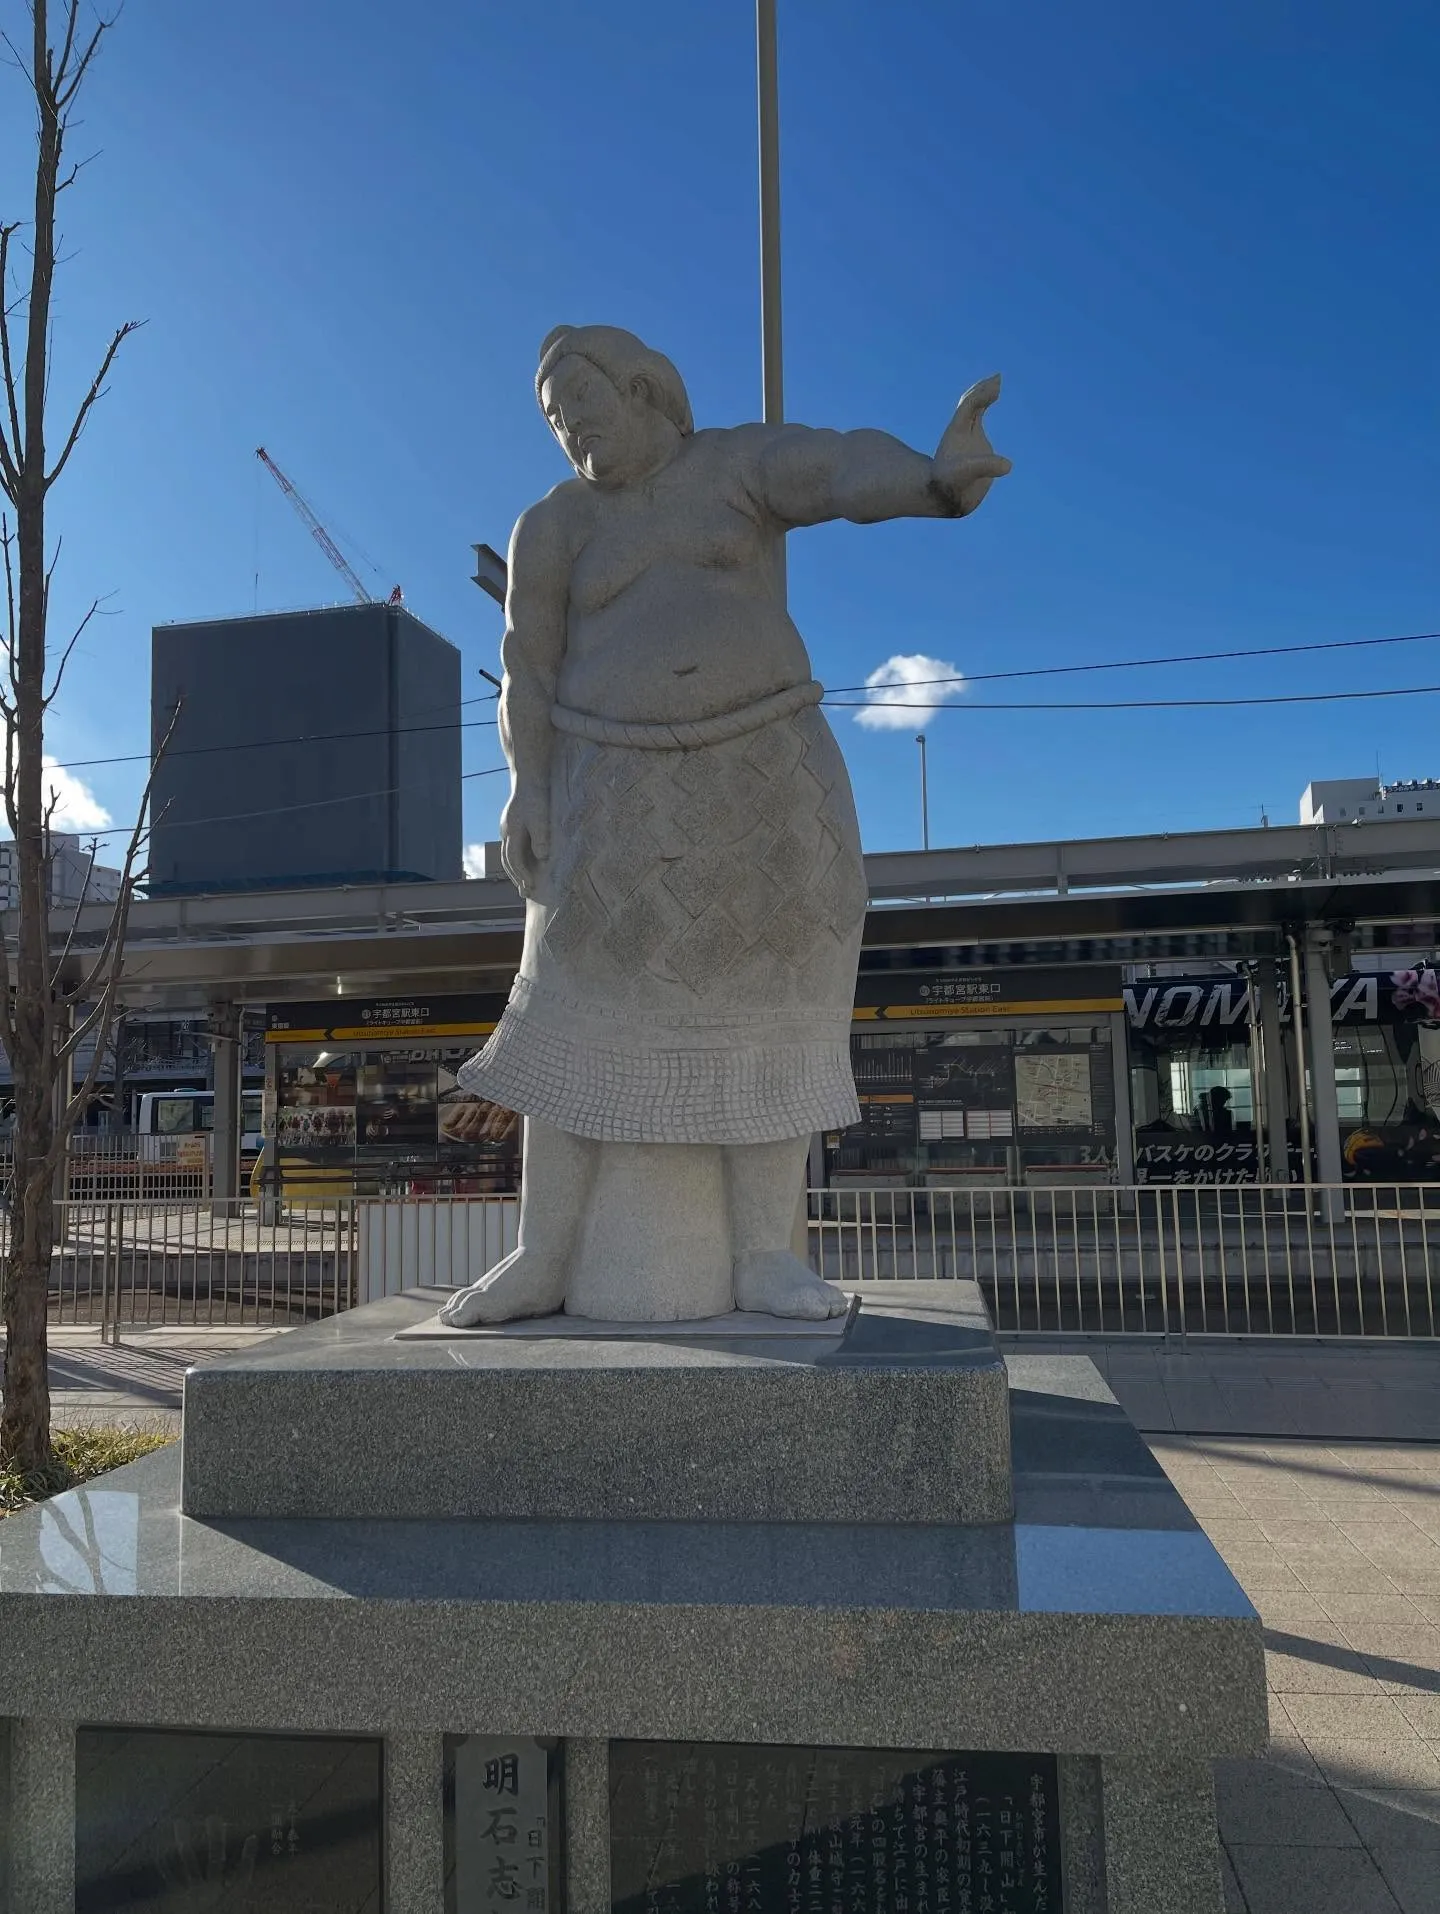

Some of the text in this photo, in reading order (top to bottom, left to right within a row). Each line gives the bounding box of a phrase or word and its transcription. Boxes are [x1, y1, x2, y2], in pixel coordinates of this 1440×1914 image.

[372, 1007, 430, 1019] 宇都宮駅東口
[480, 1752, 523, 1914] 明石志
[1029, 1771, 1048, 1912] 宇都宮市が生んだ
